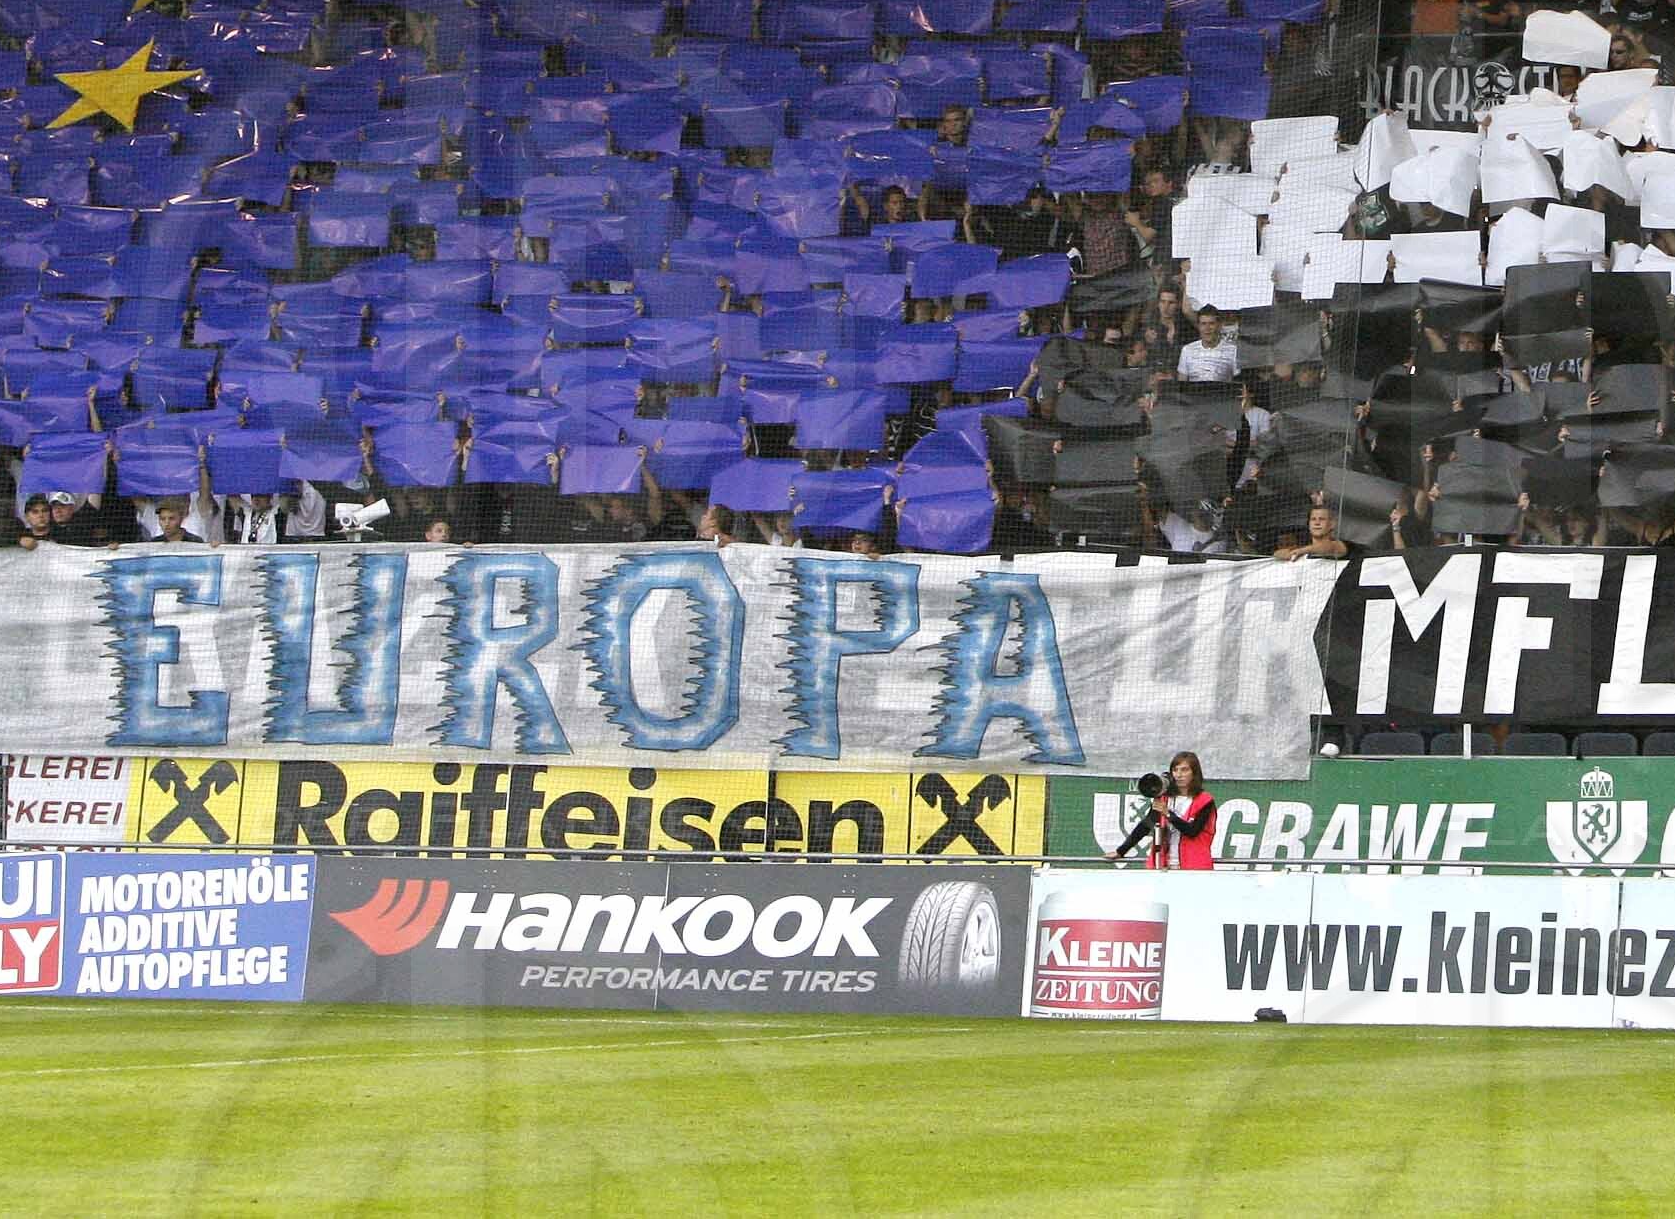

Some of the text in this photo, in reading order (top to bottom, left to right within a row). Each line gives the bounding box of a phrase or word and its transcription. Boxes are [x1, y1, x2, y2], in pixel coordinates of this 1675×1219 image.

[86, 552, 1086, 766] EUROPA
[275, 761, 885, 863] Raiffeisen
[78, 857, 312, 917] MOTORENÖLE
[78, 909, 239, 953] ADDITIVE
[1038, 926, 1164, 968] KLEINE
[74, 947, 289, 995] AUTOPFLEGE
[520, 965, 878, 993] PERFORMANCE TIRES
[1035, 978, 1161, 1004] ZEITUNG
